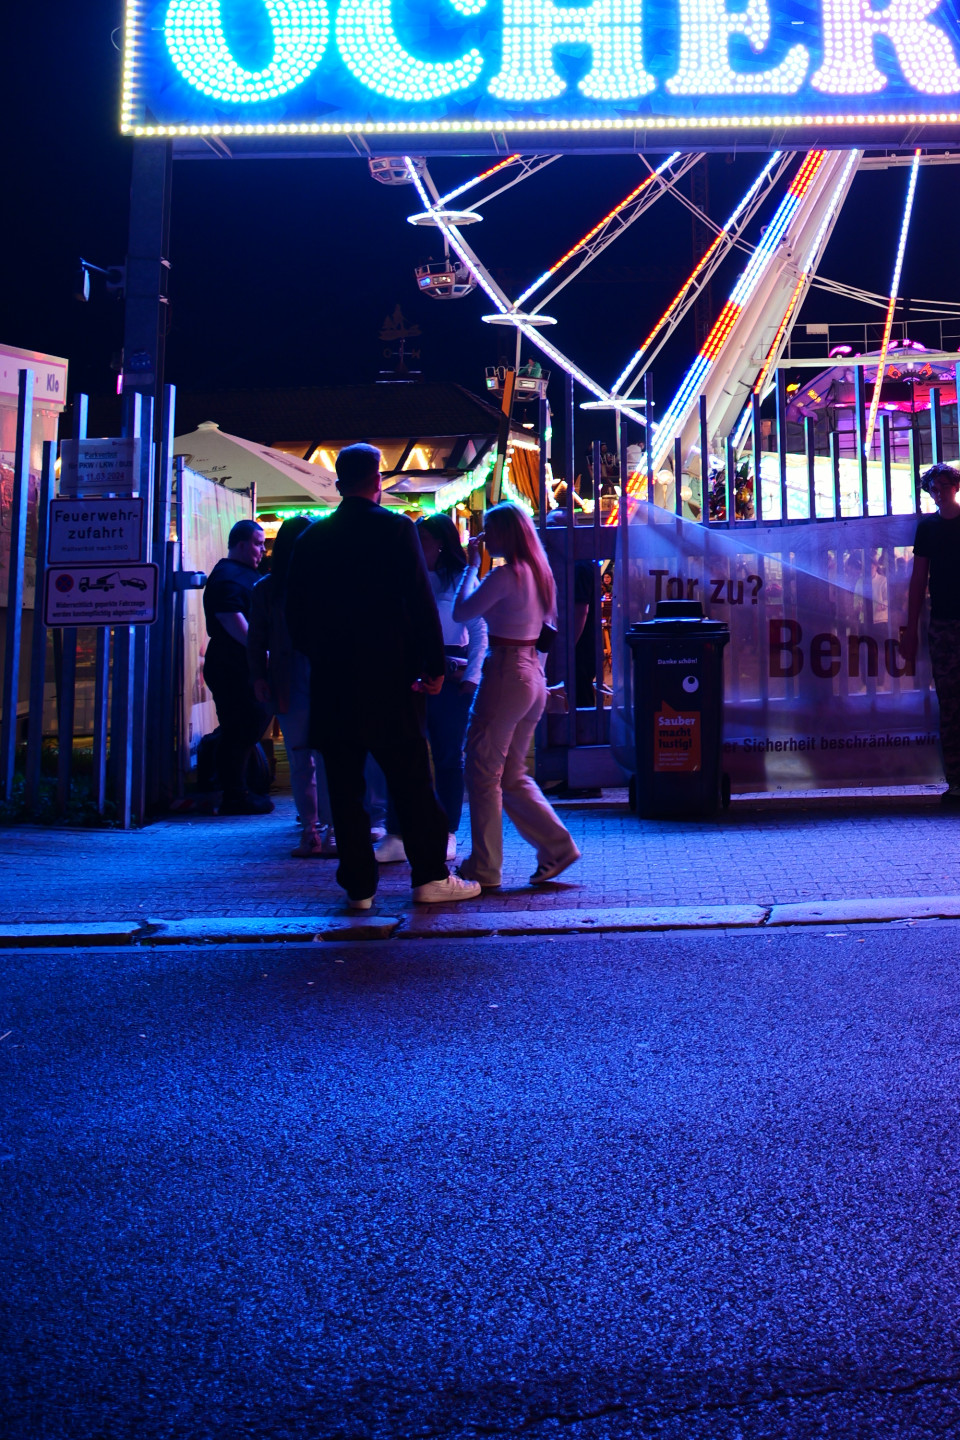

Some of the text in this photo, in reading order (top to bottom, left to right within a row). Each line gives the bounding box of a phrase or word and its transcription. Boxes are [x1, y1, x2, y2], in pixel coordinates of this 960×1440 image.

[46, 373, 59, 392] Klo
[55, 509, 139, 522] Feuerwehr-
[68, 526, 124, 539] zufahrt
[649, 569, 763, 605] Tor zu?
[658, 715, 696, 726] Sauber
[658, 727, 692, 737] macht
[658, 738, 693, 751] lustig!
[743, 736, 816, 753] Sicherheit
[820, 734, 910, 750] beschränken
[915, 732, 937, 746] wir
